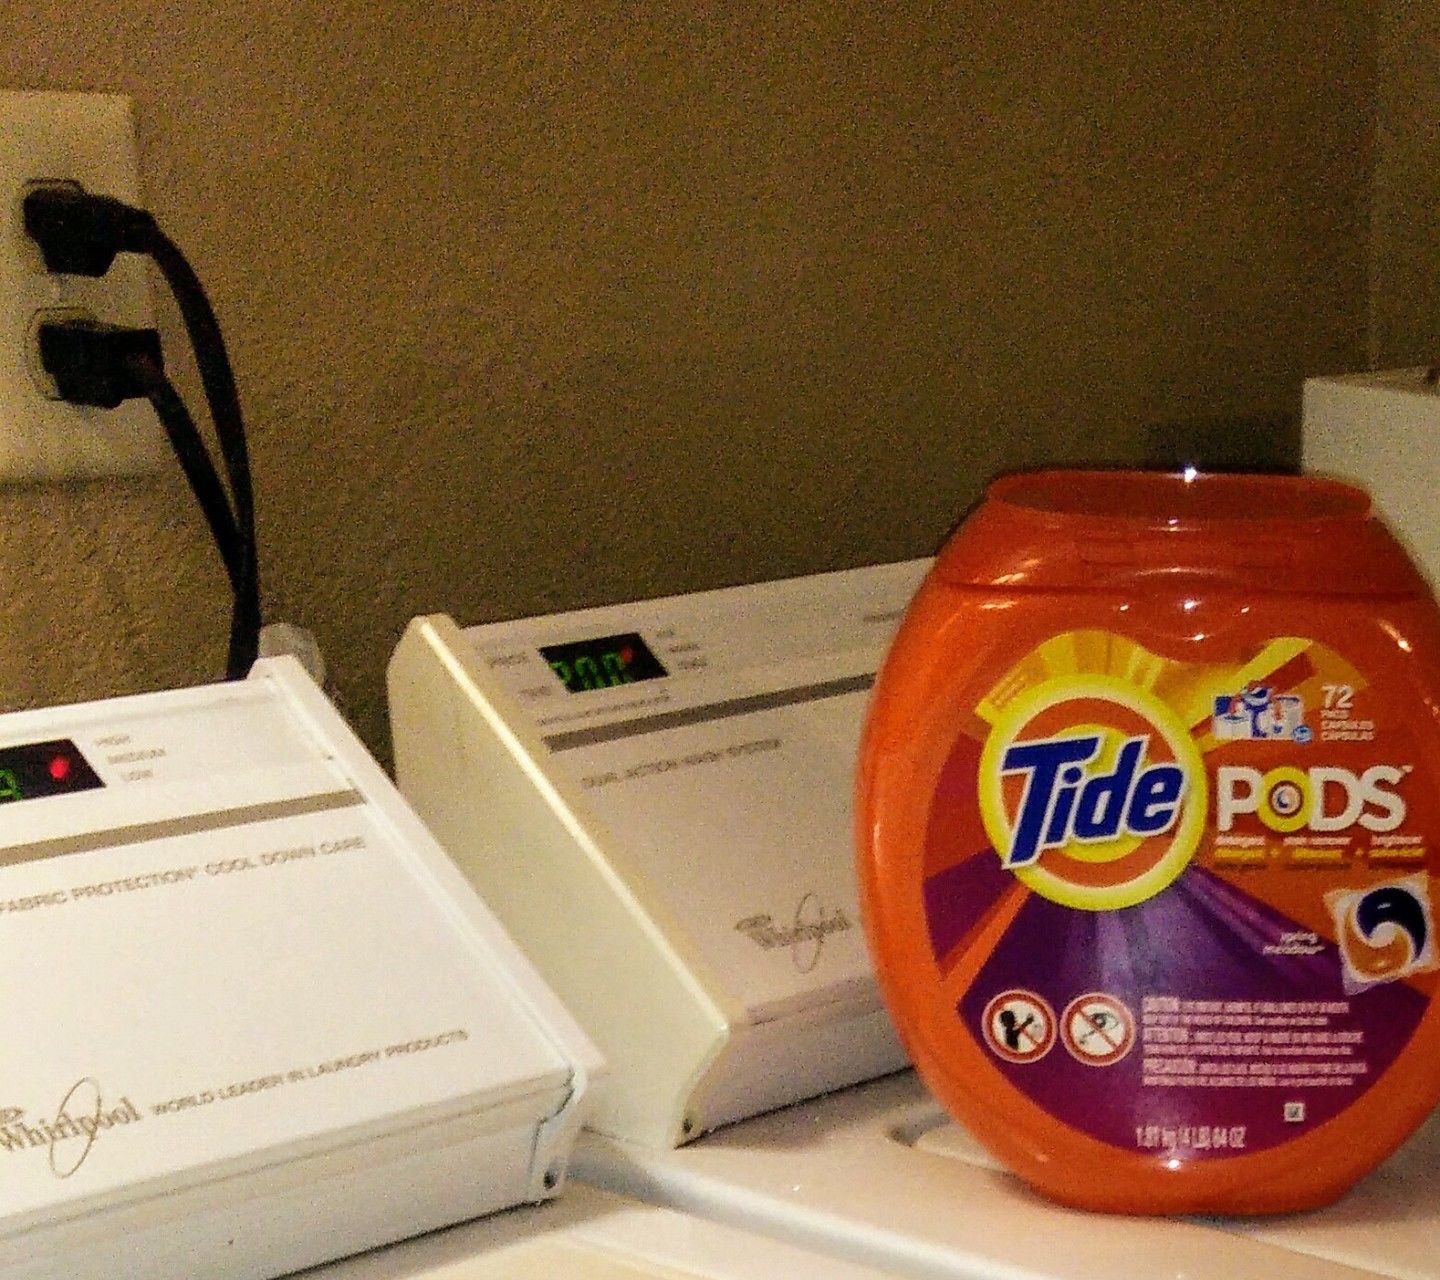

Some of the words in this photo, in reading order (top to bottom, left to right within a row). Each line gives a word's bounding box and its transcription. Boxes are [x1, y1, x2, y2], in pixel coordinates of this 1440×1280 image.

[1320, 684, 1353, 709] 72
[1002, 734, 1188, 868] Tide
[1217, 764, 1407, 833] PODS
[205, 857, 257, 876] COOL
[261, 847, 316, 867] DOWN
[320, 835, 367, 856] CARE
[152, 1090, 214, 1116] WORLD
[218, 1074, 284, 1101] LEADER
